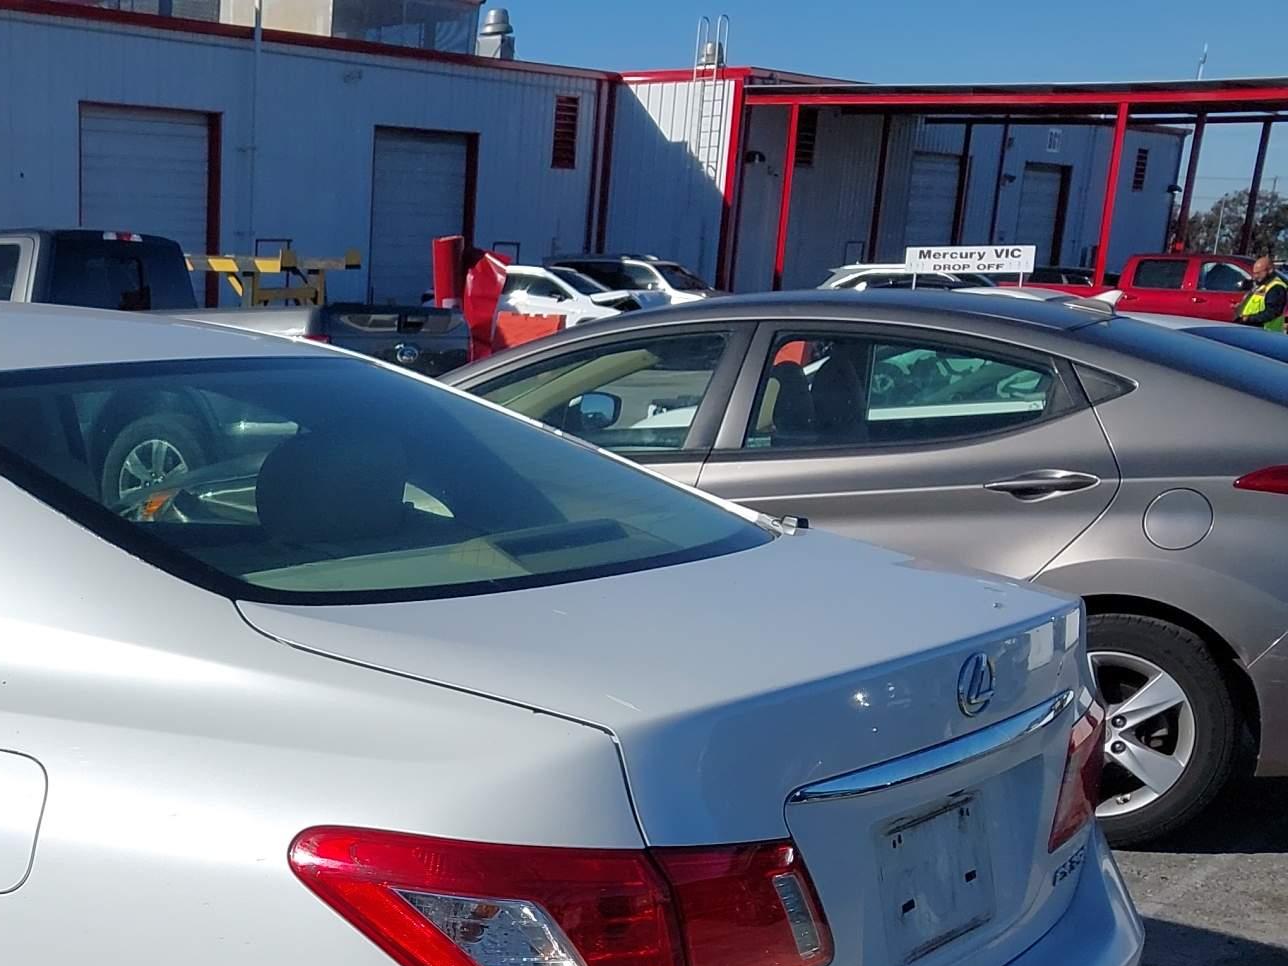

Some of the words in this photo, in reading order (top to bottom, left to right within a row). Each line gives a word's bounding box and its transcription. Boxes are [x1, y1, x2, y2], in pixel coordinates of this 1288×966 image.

[918, 248, 987, 261] Mercury
[994, 248, 1022, 259] VIC
[932, 263, 970, 271] DROP
[976, 263, 1004, 271] OFF
